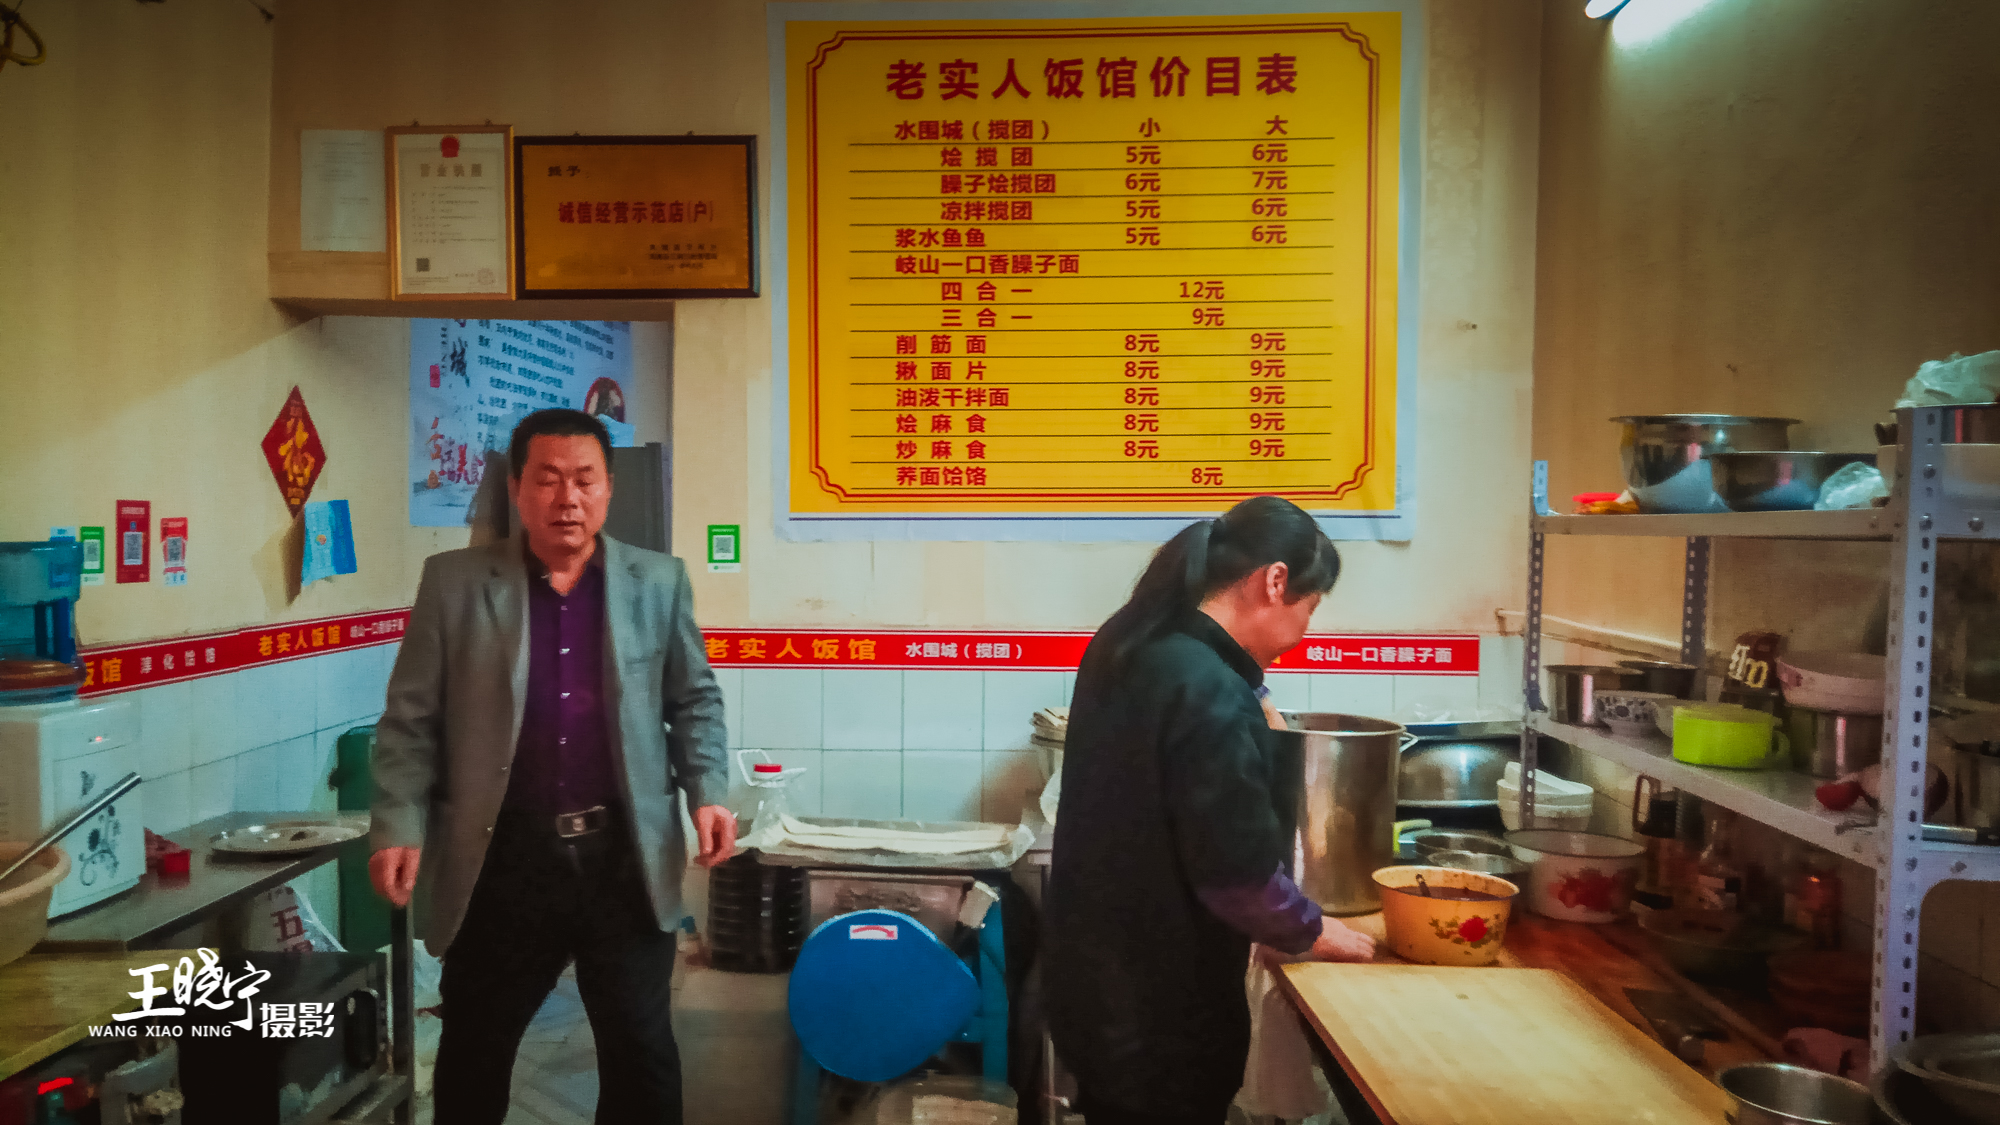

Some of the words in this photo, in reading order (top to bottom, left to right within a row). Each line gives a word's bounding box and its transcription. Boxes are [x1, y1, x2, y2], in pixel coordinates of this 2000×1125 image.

[887, 53, 1297, 101] 老实人饭馆价目表
[895, 119, 1050, 141] 水围城（搅团）
[1139, 118, 1161, 137] 小
[1267, 115, 1287, 135] 大
[1126, 145, 1161, 165] 5元
[1252, 143, 1288, 163] 6元
[940, 173, 1057, 195] 臊子烩搅团
[1125, 171, 1161, 192] 6元
[1252, 170, 1287, 190] 7元
[558, 200, 715, 225] 诚信经营示范店(户)
[940, 200, 1034, 221] 凉拌搅团
[1126, 198, 1161, 219] 5元
[1251, 196, 1287, 217] 6元
[895, 227, 987, 249] 浆水鱼鱼
[1126, 225, 1161, 246] 5元
[1251, 223, 1287, 244] 6元
[894, 253, 1080, 276] 岐山一口香臊子面
[1180, 280, 1225, 301] 12元
[1192, 306, 1225, 327] 9元
[1124, 333, 1160, 353] 8元
[1250, 331, 1286, 352] 9元
[1123, 359, 1160, 380] 8元
[1249, 358, 1286, 379] 9元
[895, 386, 1010, 408] 油泼干拌面
[1123, 386, 1160, 407] 8元
[1249, 384, 1286, 405] 9元
[1123, 412, 1160, 433] 8元
[1249, 411, 1286, 432] 9元
[1123, 439, 1160, 460] 8元
[1248, 437, 1286, 458] 9元
[895, 466, 988, 487] 荞面饸饹
[1190, 466, 1224, 487] 8元
[257, 625, 342, 657] 老实人饭馆
[706, 637, 877, 661] 老实人饭馆
[1306, 645, 1453, 663] 岐山一口香臊子面
